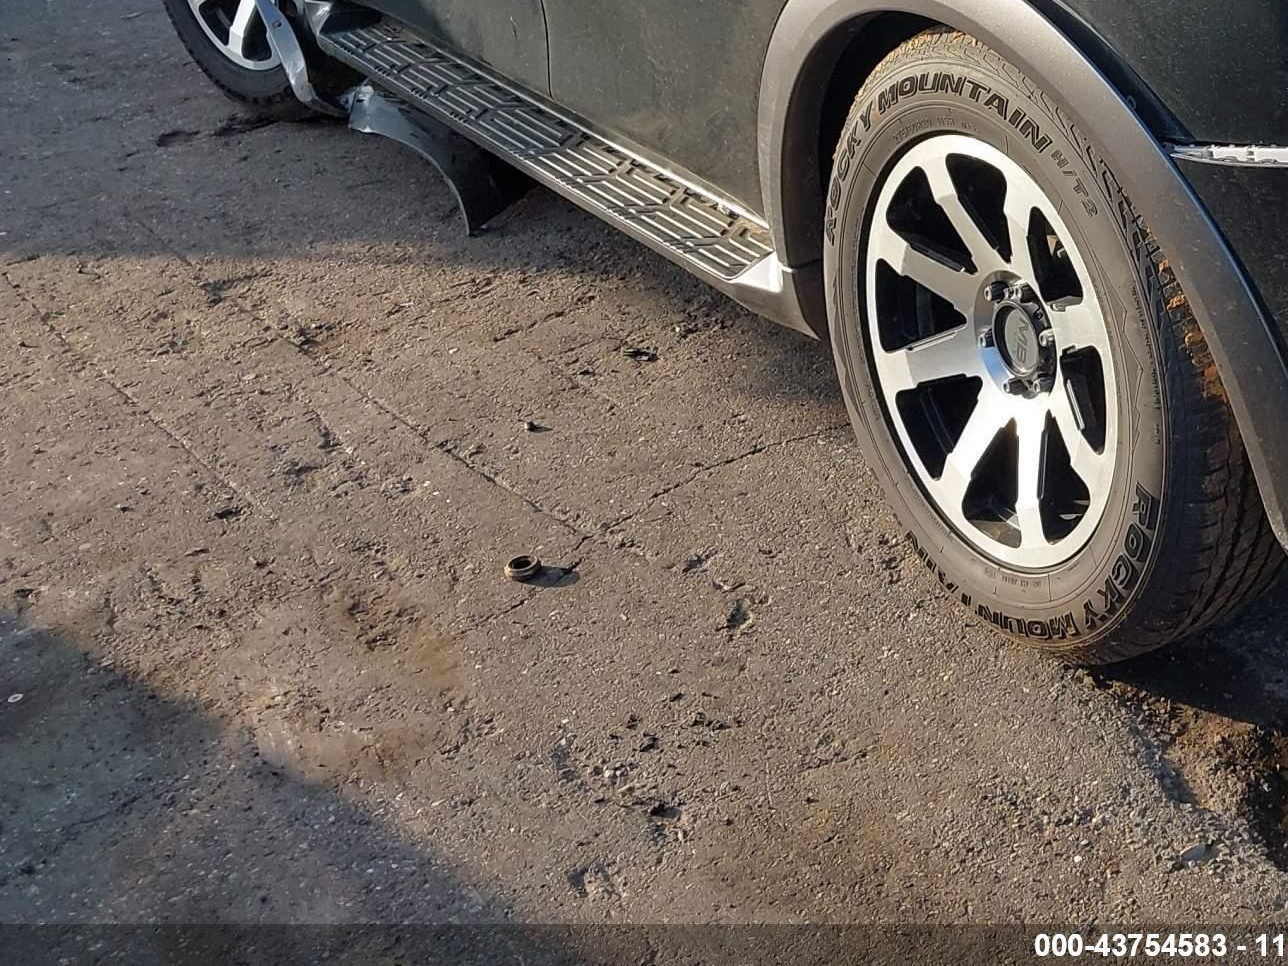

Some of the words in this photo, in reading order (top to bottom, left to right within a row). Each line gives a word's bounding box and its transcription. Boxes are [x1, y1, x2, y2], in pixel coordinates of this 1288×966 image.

[823, 98, 877, 248] ROCKY
[877, 70, 1053, 154] MOUNTAIN
[1083, 481, 1160, 630] ROCKY
